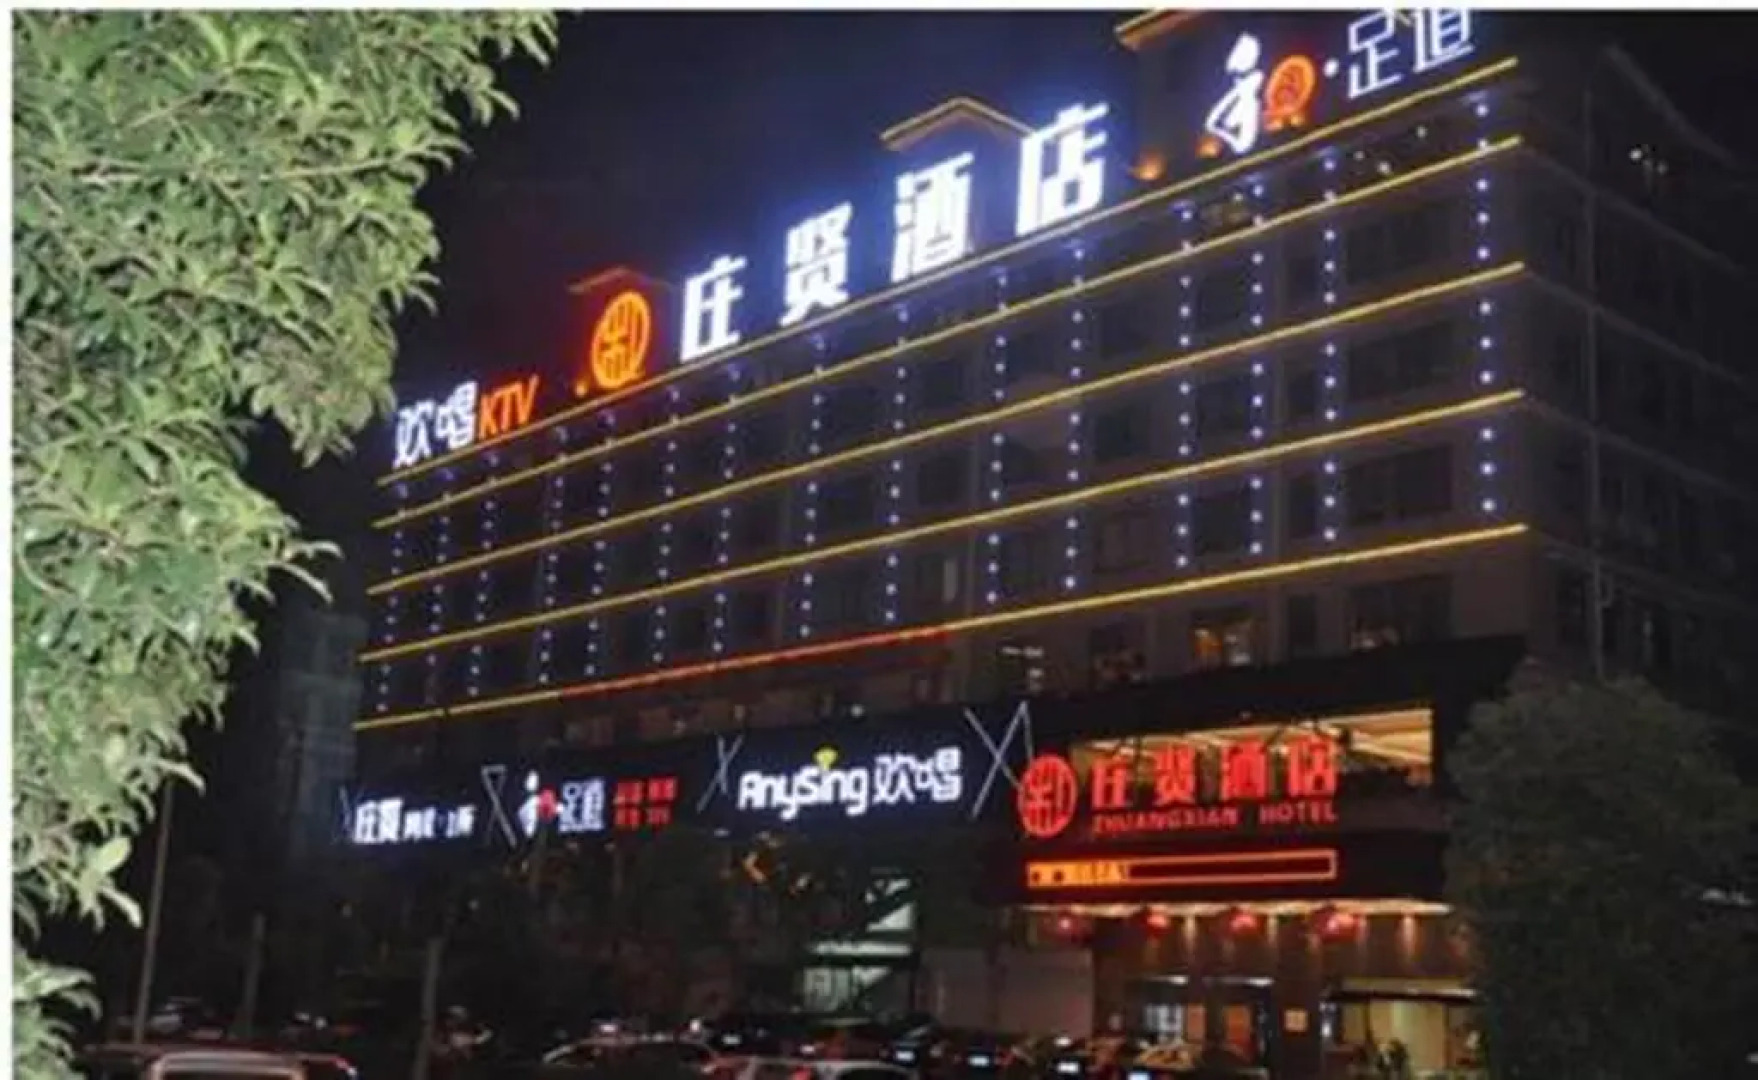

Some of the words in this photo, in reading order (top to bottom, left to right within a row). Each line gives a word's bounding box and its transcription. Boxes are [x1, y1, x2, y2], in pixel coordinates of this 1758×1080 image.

[679, 103, 1109, 363] 庄贤酒店
[479, 375, 539, 439] KTV
[737, 750, 868, 820] AnySing
[1092, 735, 1337, 808] 庄贤酒店
[1259, 802, 1337, 824] HOTEL
